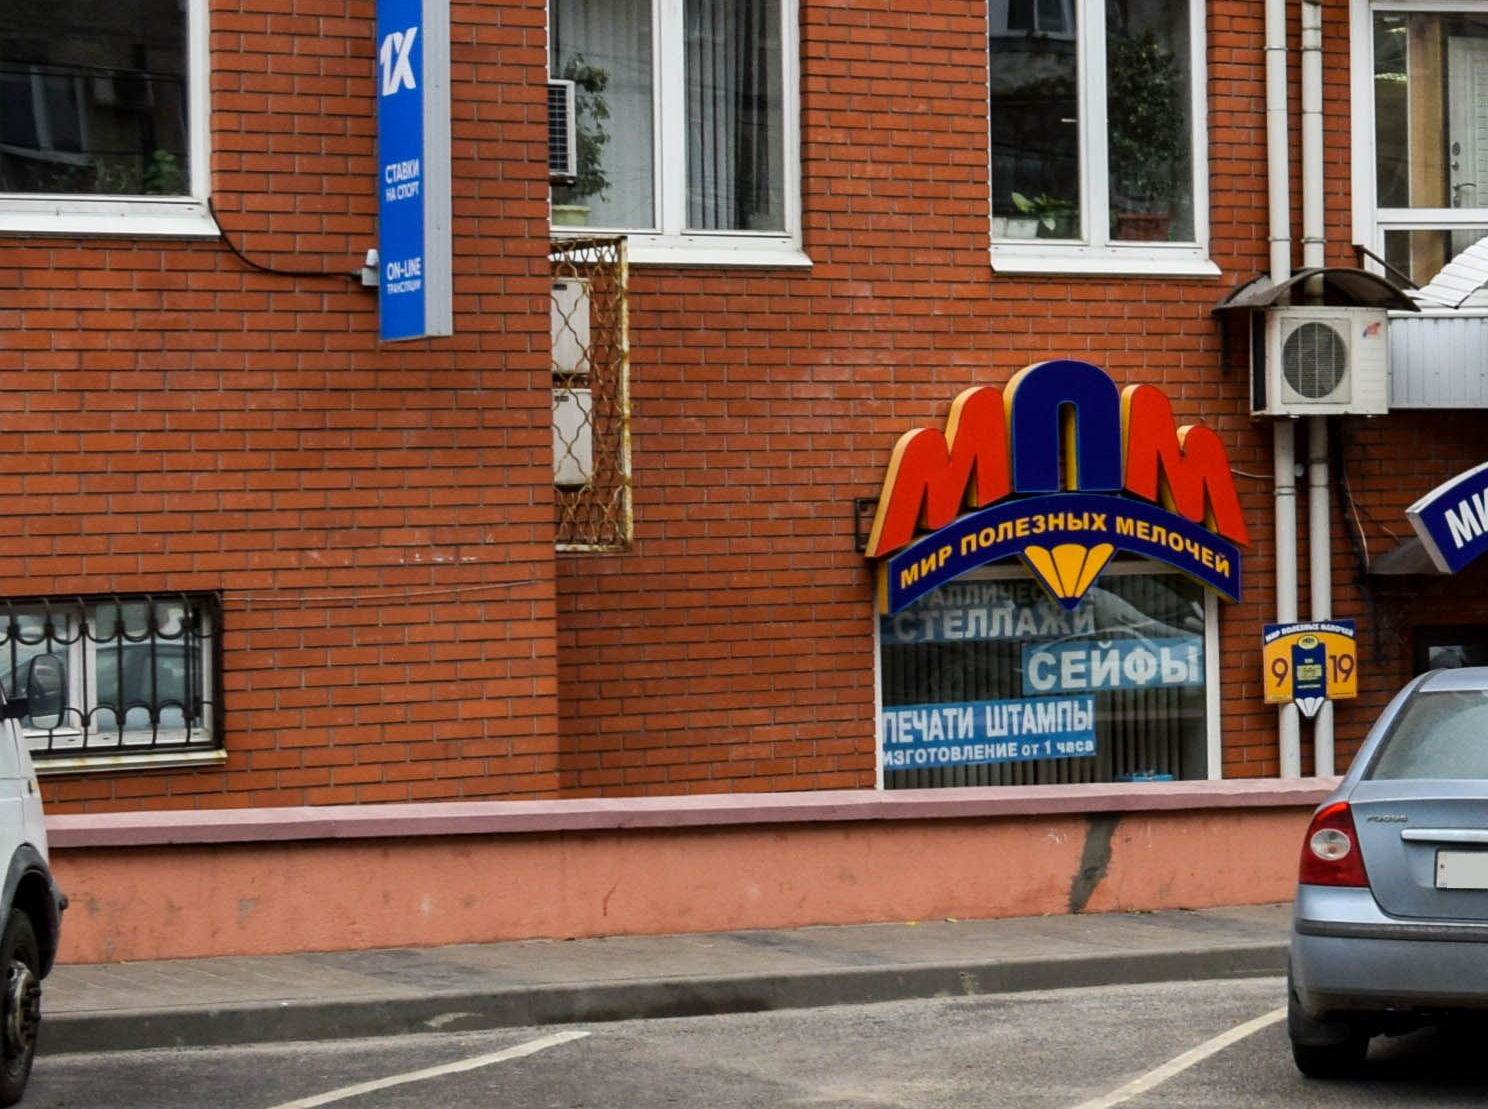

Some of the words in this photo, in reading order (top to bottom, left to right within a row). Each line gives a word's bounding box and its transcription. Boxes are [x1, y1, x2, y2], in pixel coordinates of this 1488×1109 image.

[385, 159, 419, 184] СТАВКИ
[386, 187, 396, 202] НА
[397, 182, 418, 199] СПОРТ
[387, 257, 421, 280] ON-LINE
[866, 359, 1250, 557] МПМ
[901, 546, 953, 589] МИР
[960, 513, 1107, 556] ПОЛЕЗНЫХ
[1115, 516, 1230, 578] МЕЛОЧЕЙ
[894, 604, 1096, 640] СТЕЛЛАЖИ
[1028, 640, 1199, 691] СЕЙФЫ
[1271, 657, 1289, 688] 9
[1328, 654, 1355, 683] 19
[882, 706, 975, 743] ПЕЧАТИ
[985, 699, 1093, 738] ШТАМПЫ
[882, 742, 1018, 767] ИЗГОТОВЛЕНИЕ
[1021, 744, 1040, 756] от
[1044, 741, 1051, 754] 1
[1056, 740, 1094, 753] часа
